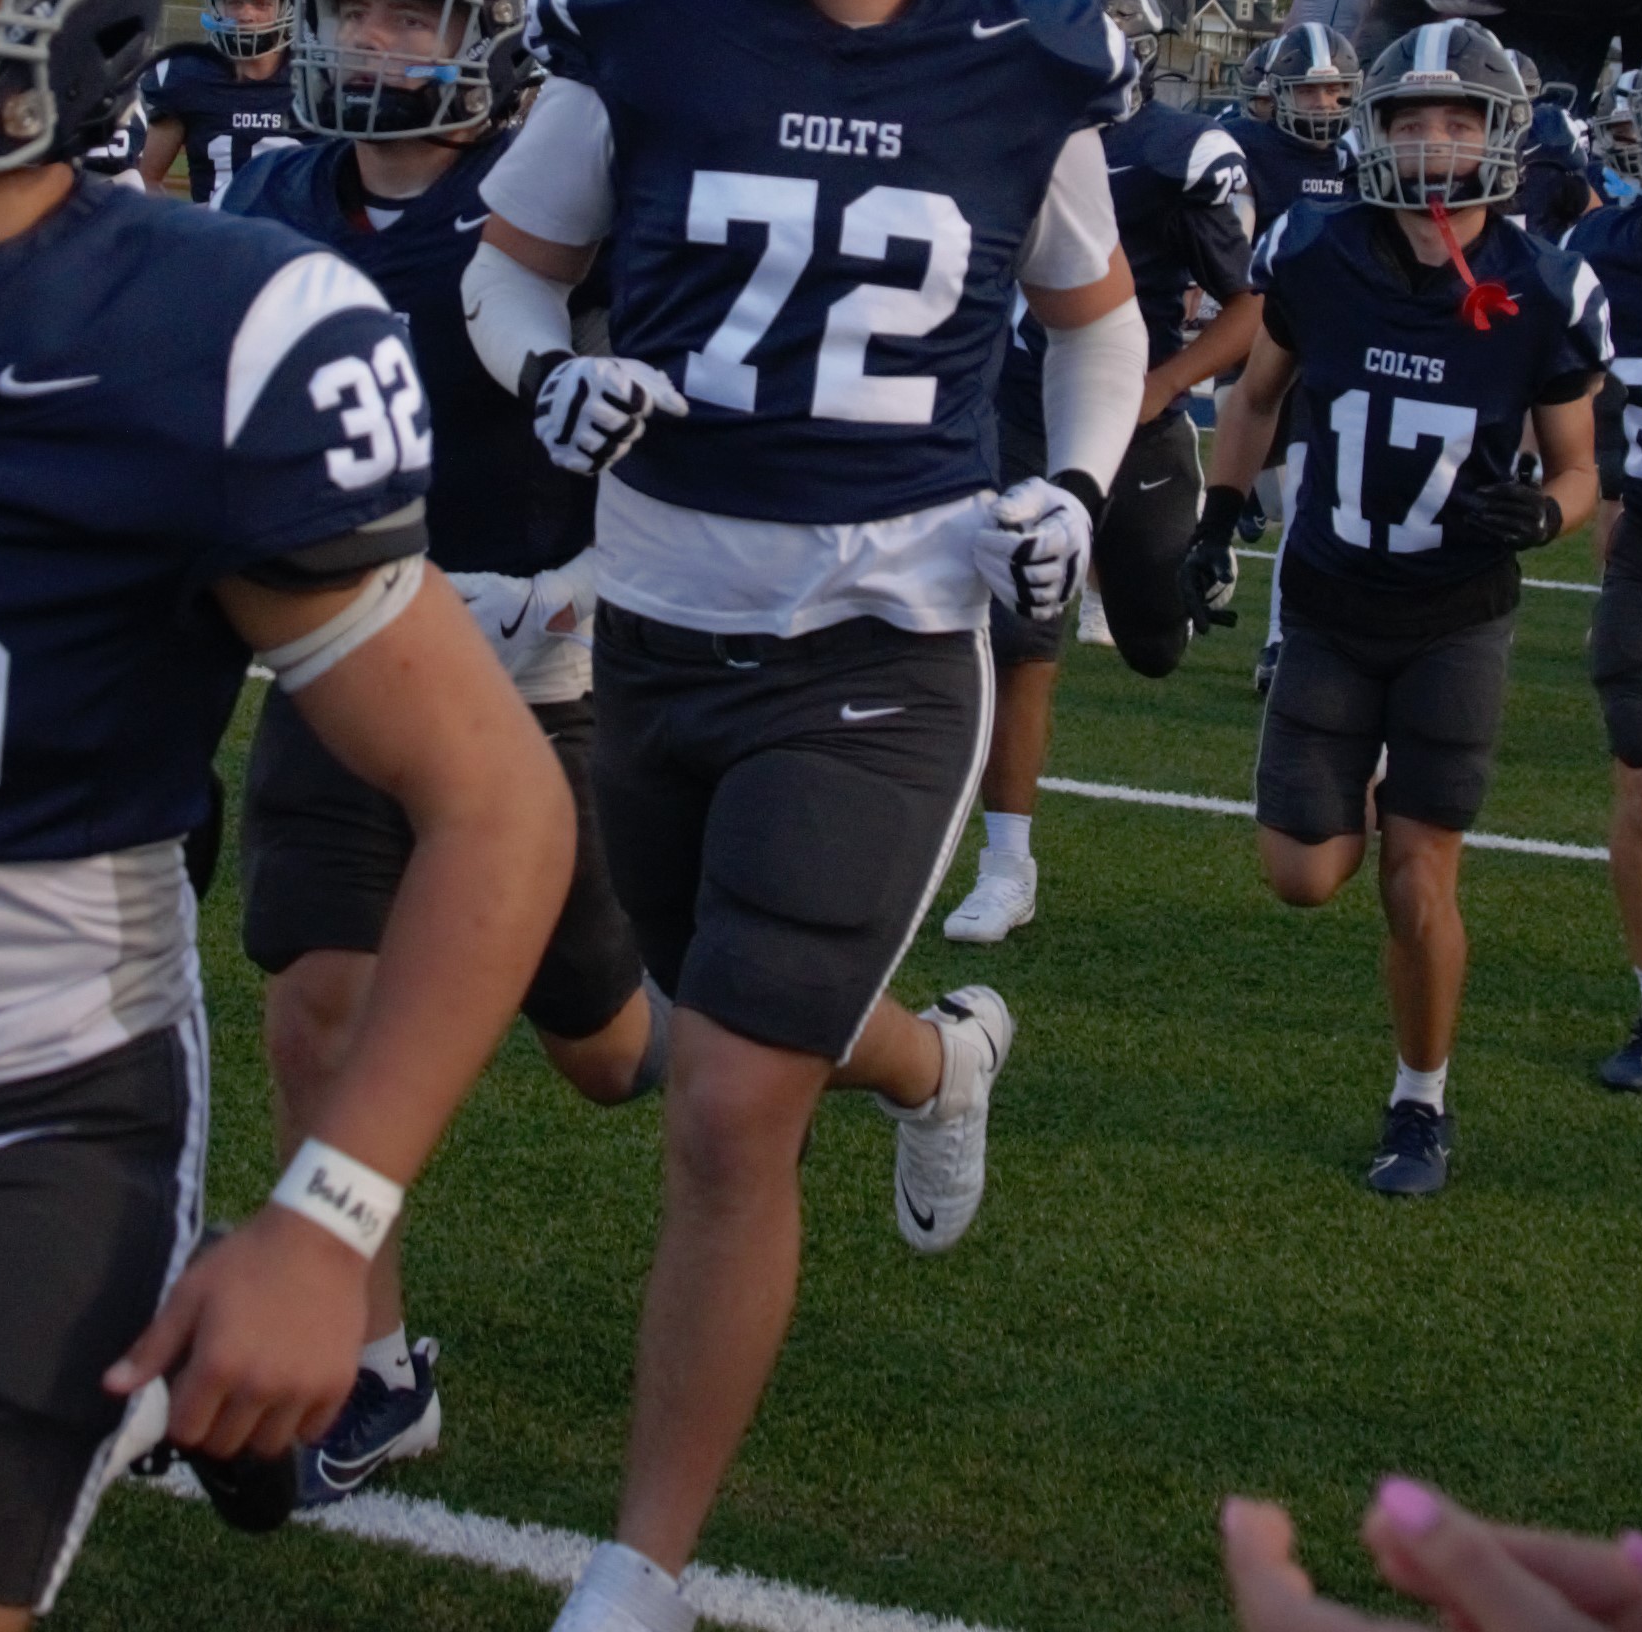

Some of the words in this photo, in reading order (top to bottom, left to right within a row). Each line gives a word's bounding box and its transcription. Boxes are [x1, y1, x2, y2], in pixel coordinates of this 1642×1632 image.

[232, 112, 282, 129] COLTS
[779, 112, 902, 158] COLTS
[1302, 178, 1344, 195] COLTS
[685, 170, 971, 424] 72
[1365, 347, 1446, 384] COLTS
[308, 334, 433, 491] 32
[1330, 390, 1477, 554] 17
